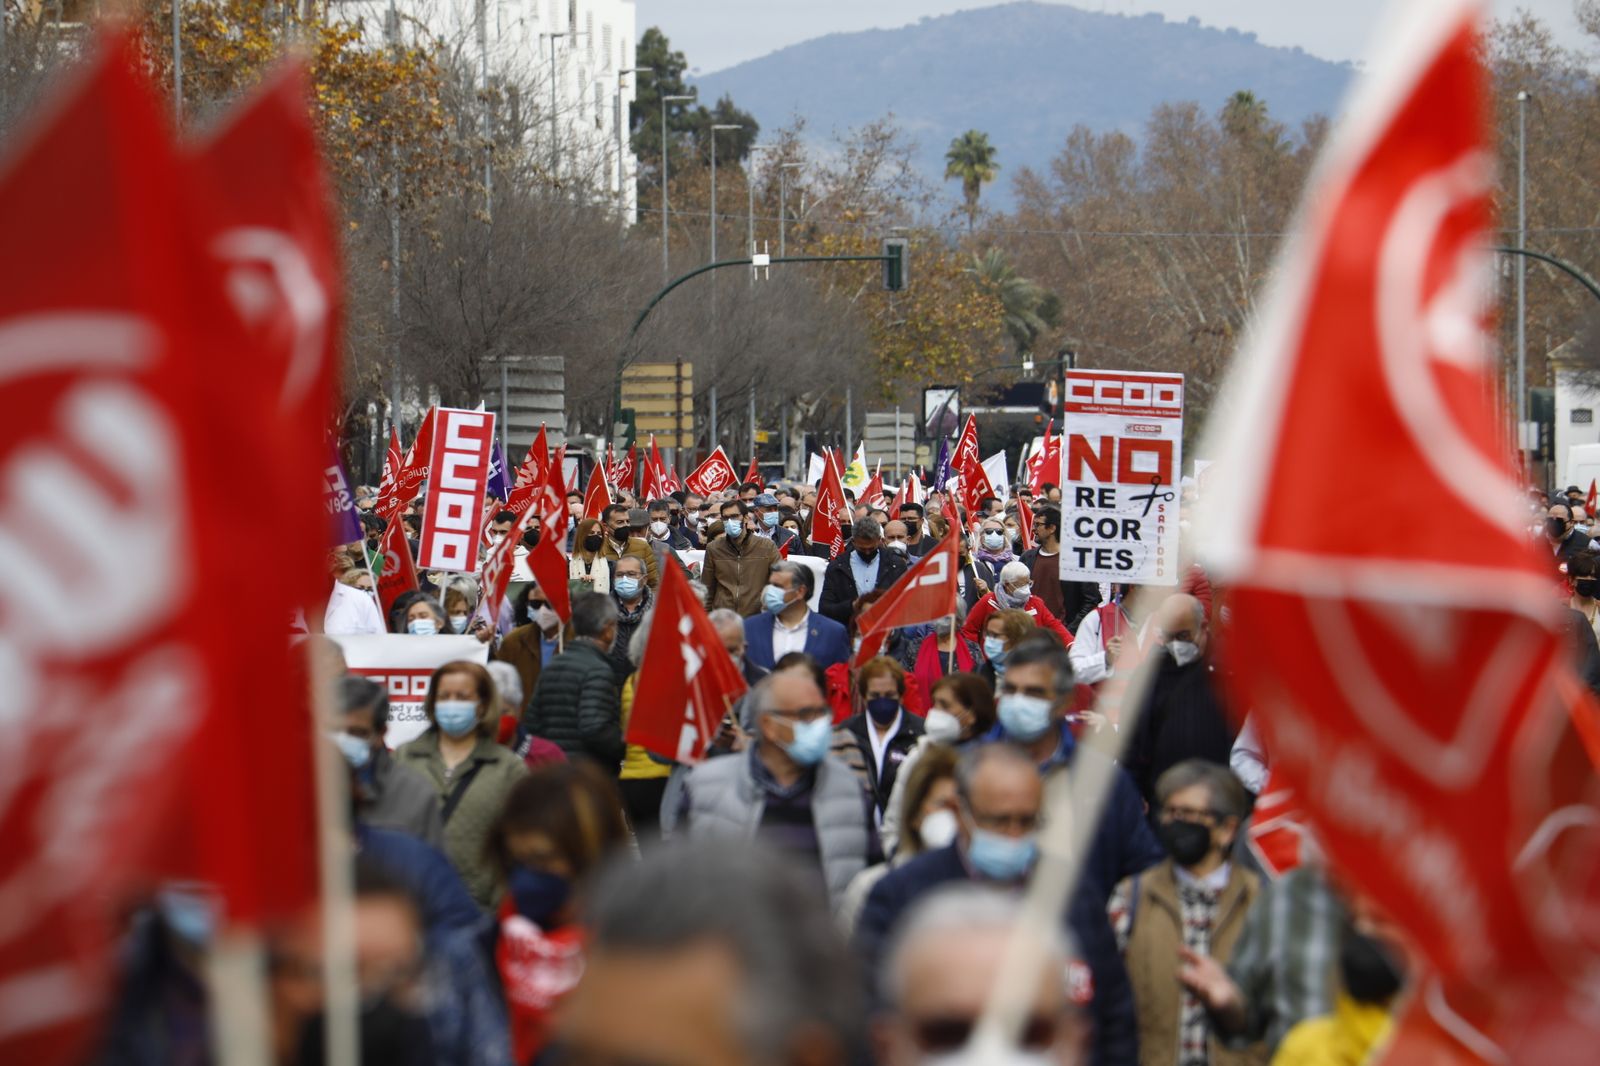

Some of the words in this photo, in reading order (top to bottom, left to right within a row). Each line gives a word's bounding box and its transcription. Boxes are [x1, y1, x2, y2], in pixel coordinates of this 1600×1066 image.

[1065, 378, 1182, 408] CCOO
[1068, 434, 1173, 486] NO
[701, 462, 724, 484] UGT
[429, 412, 485, 567] CCOO
[1075, 486, 1116, 508] RE
[1073, 517, 1142, 541] COR
[1072, 547, 1134, 571] TES
